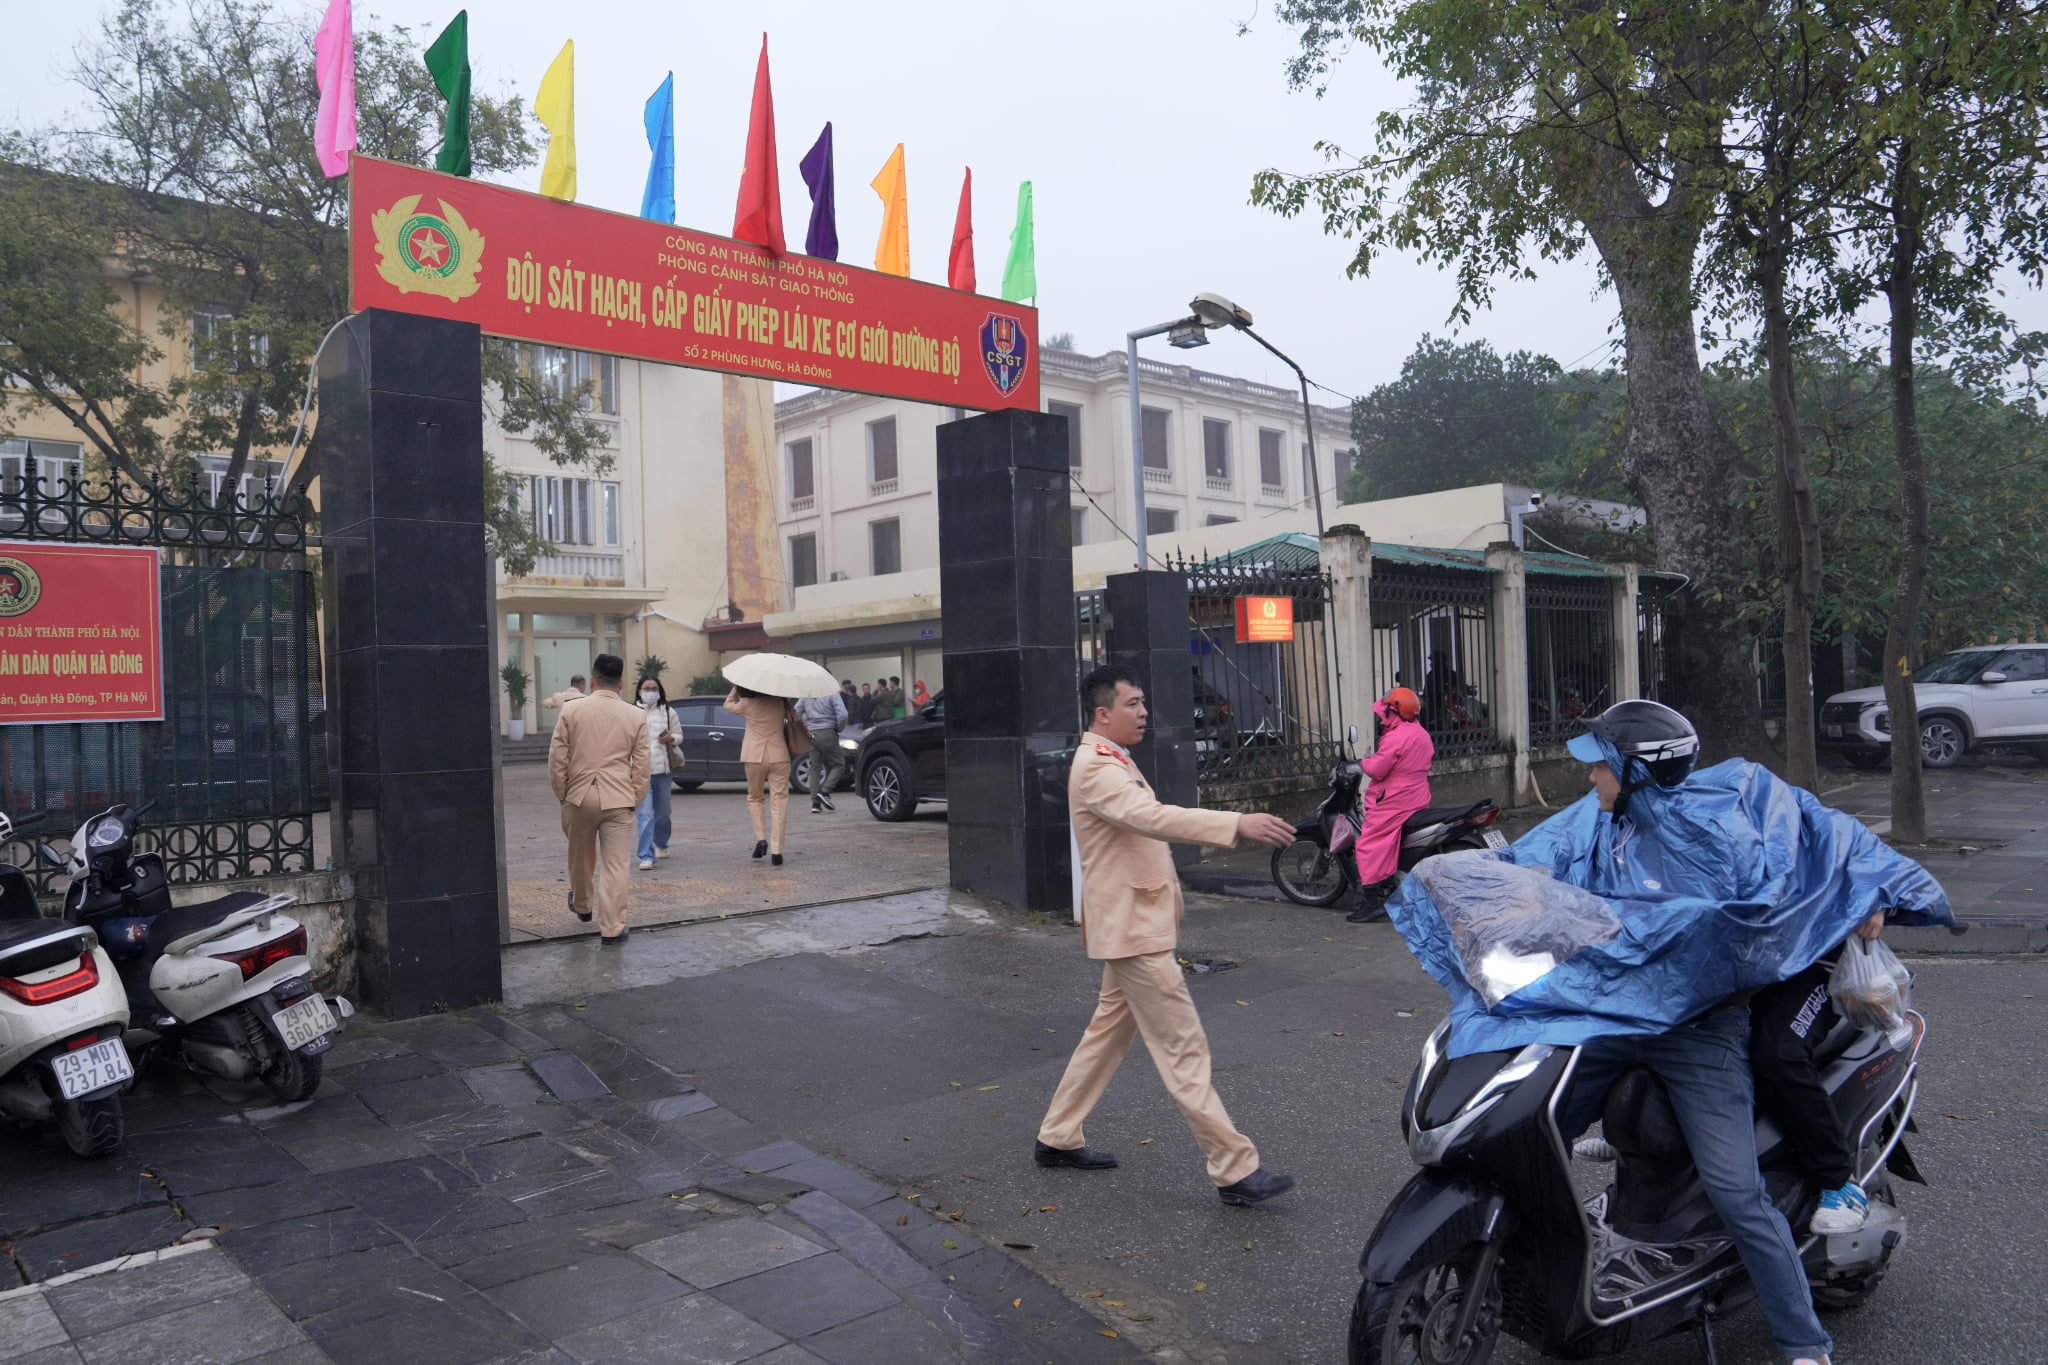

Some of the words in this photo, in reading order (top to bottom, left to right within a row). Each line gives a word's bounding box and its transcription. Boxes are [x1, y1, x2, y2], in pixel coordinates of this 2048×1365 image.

[658, 252, 707, 274] PHÒNG
[711, 263, 748, 283] CẢNH
[751, 272, 776, 288] SÁT
[779, 279, 810, 296] GIAO
[813, 285, 854, 304] THÔNG
[665, 235, 706, 255] CÔNG
[709, 246, 728, 260] AN
[732, 249, 775, 271] THÀNH
[778, 260, 805, 277] PHỐ
[808, 267, 825, 281] HÀ
[828, 271, 848, 288] NỘI
[506, 251, 542, 314] ĐỘI
[547, 259, 586, 313] SÁT
[590, 273, 647, 329] HẠCH,
[652, 274, 688, 331] CẤP
[693, 283, 732, 338] GIẤY
[736, 297, 779, 345] PHÉP
[783, 304, 808, 352] LÁI
[811, 316, 832, 355] XE
[836, 319, 857, 358] CƠ
[860, 320, 889, 364] GIỚI
[892, 321, 939, 373] ĐƯỜNG
[942, 335, 961, 385] BỘ
[684, 343, 699, 358] SỐ
[702, 348, 708, 359] 2
[711, 350, 748, 366] PHÙNG
[751, 356, 785, 373] HƯNG,
[787, 361, 801, 373] HÀ
[803, 363, 832, 379] ĐÔNG
[987, 351, 1022, 367] CSGT
[8, 623, 32, 637] DÂN
[35, 624, 75, 638] THÀNH
[78, 623, 100, 638] PHỐ
[102, 625, 118, 638] HÀ
[121, 625, 140, 640] NỘI
[22, 649, 49, 675] DÂN
[53, 649, 87, 679] QUẬN
[90, 649, 107, 674] HÀ
[110, 649, 143, 674] ĐÔNG
[19, 693, 48, 706] Quận
[50, 692, 64, 704] Hà
[67, 692, 97, 705] Đông,
[100, 692, 112, 703] TP
[115, 692, 128, 702] Hà
[131, 692, 147, 704] Nội
[281, 999, 319, 1029] 29-D1
[286, 1013, 332, 1046] 360.42
[59, 1041, 119, 1076] 29-MD1
[66, 1060, 128, 1095] 237.84
